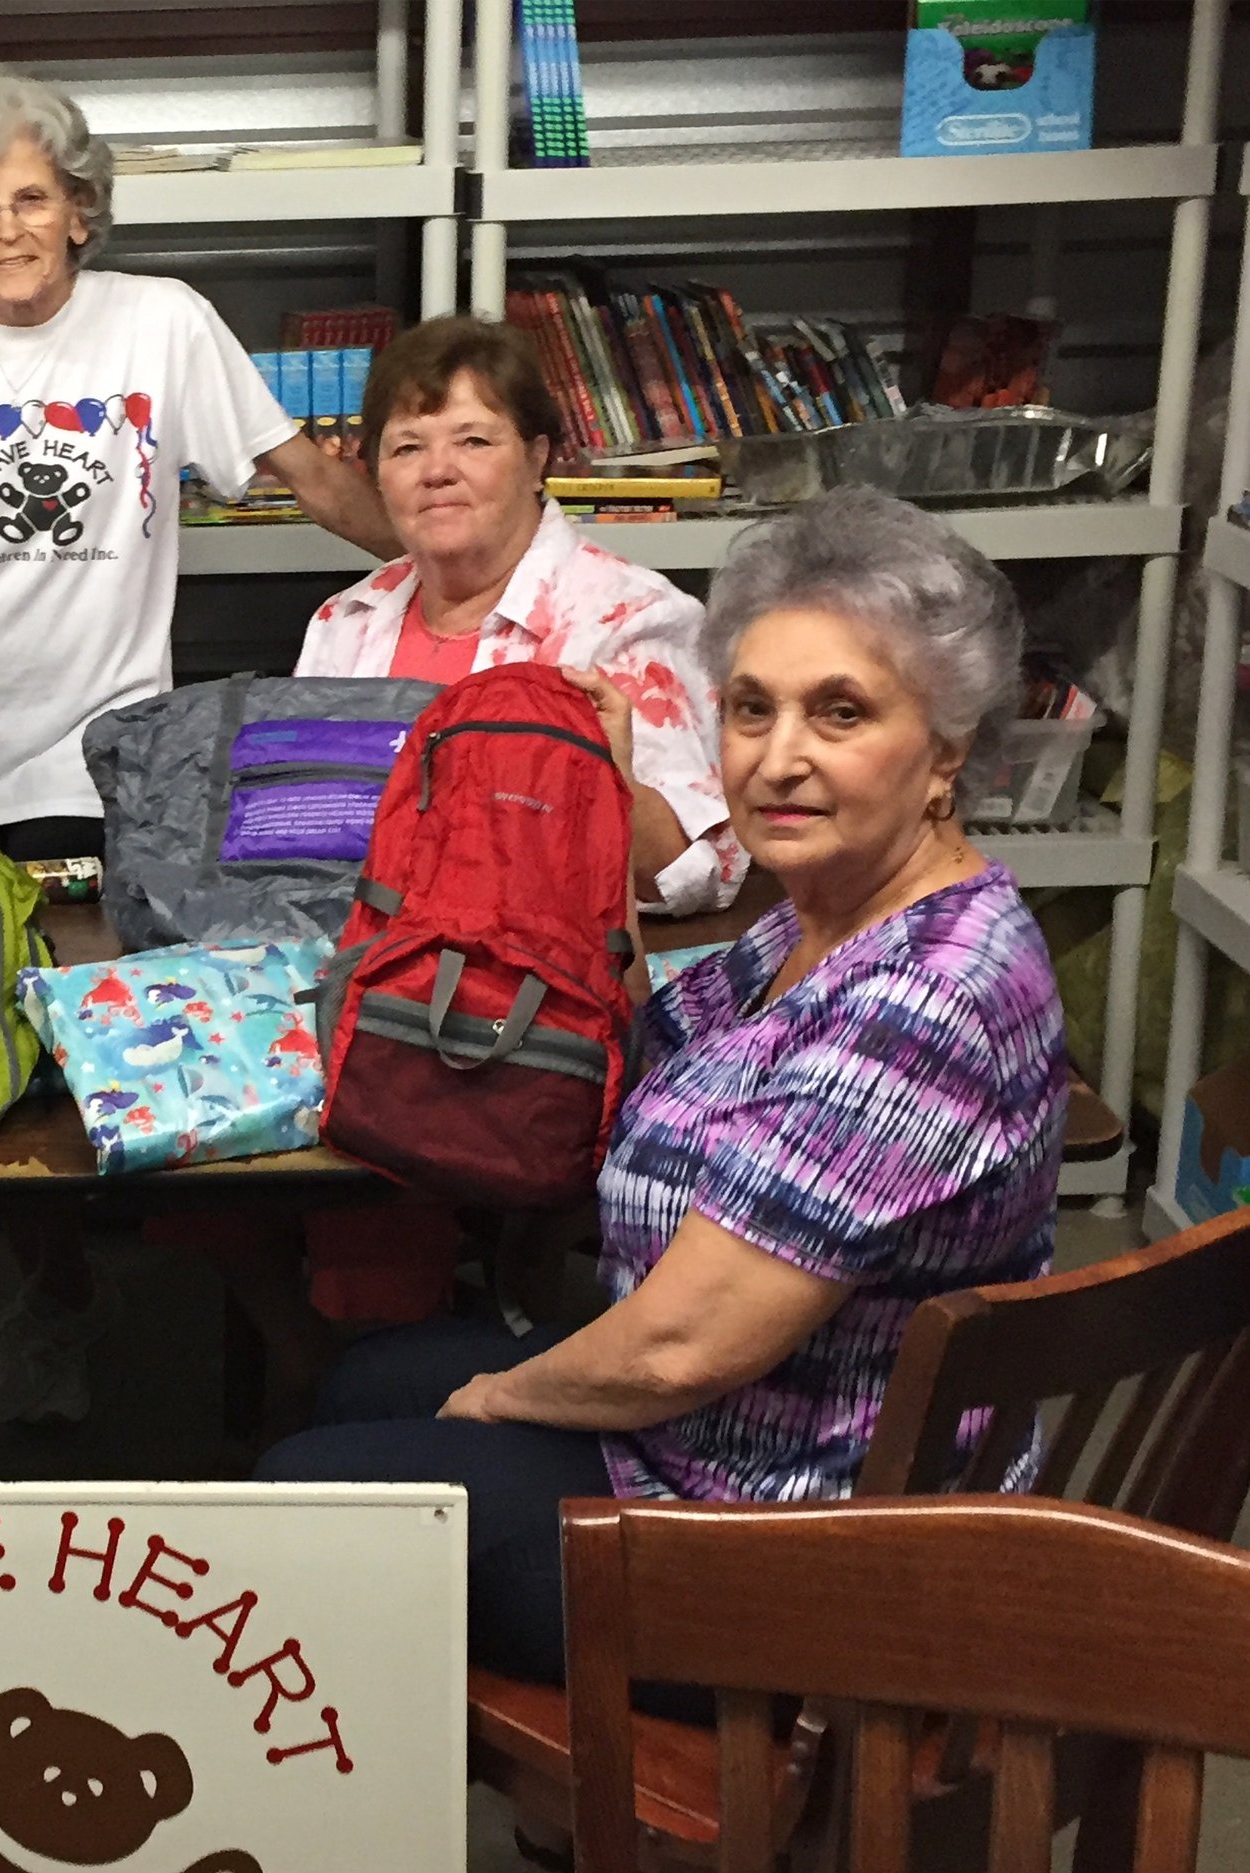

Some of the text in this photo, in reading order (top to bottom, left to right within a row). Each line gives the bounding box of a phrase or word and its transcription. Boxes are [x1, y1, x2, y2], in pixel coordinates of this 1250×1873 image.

[42, 439, 114, 485] HEART
[51, 549, 88, 563] Need
[48, 1510, 354, 1775] HEART
